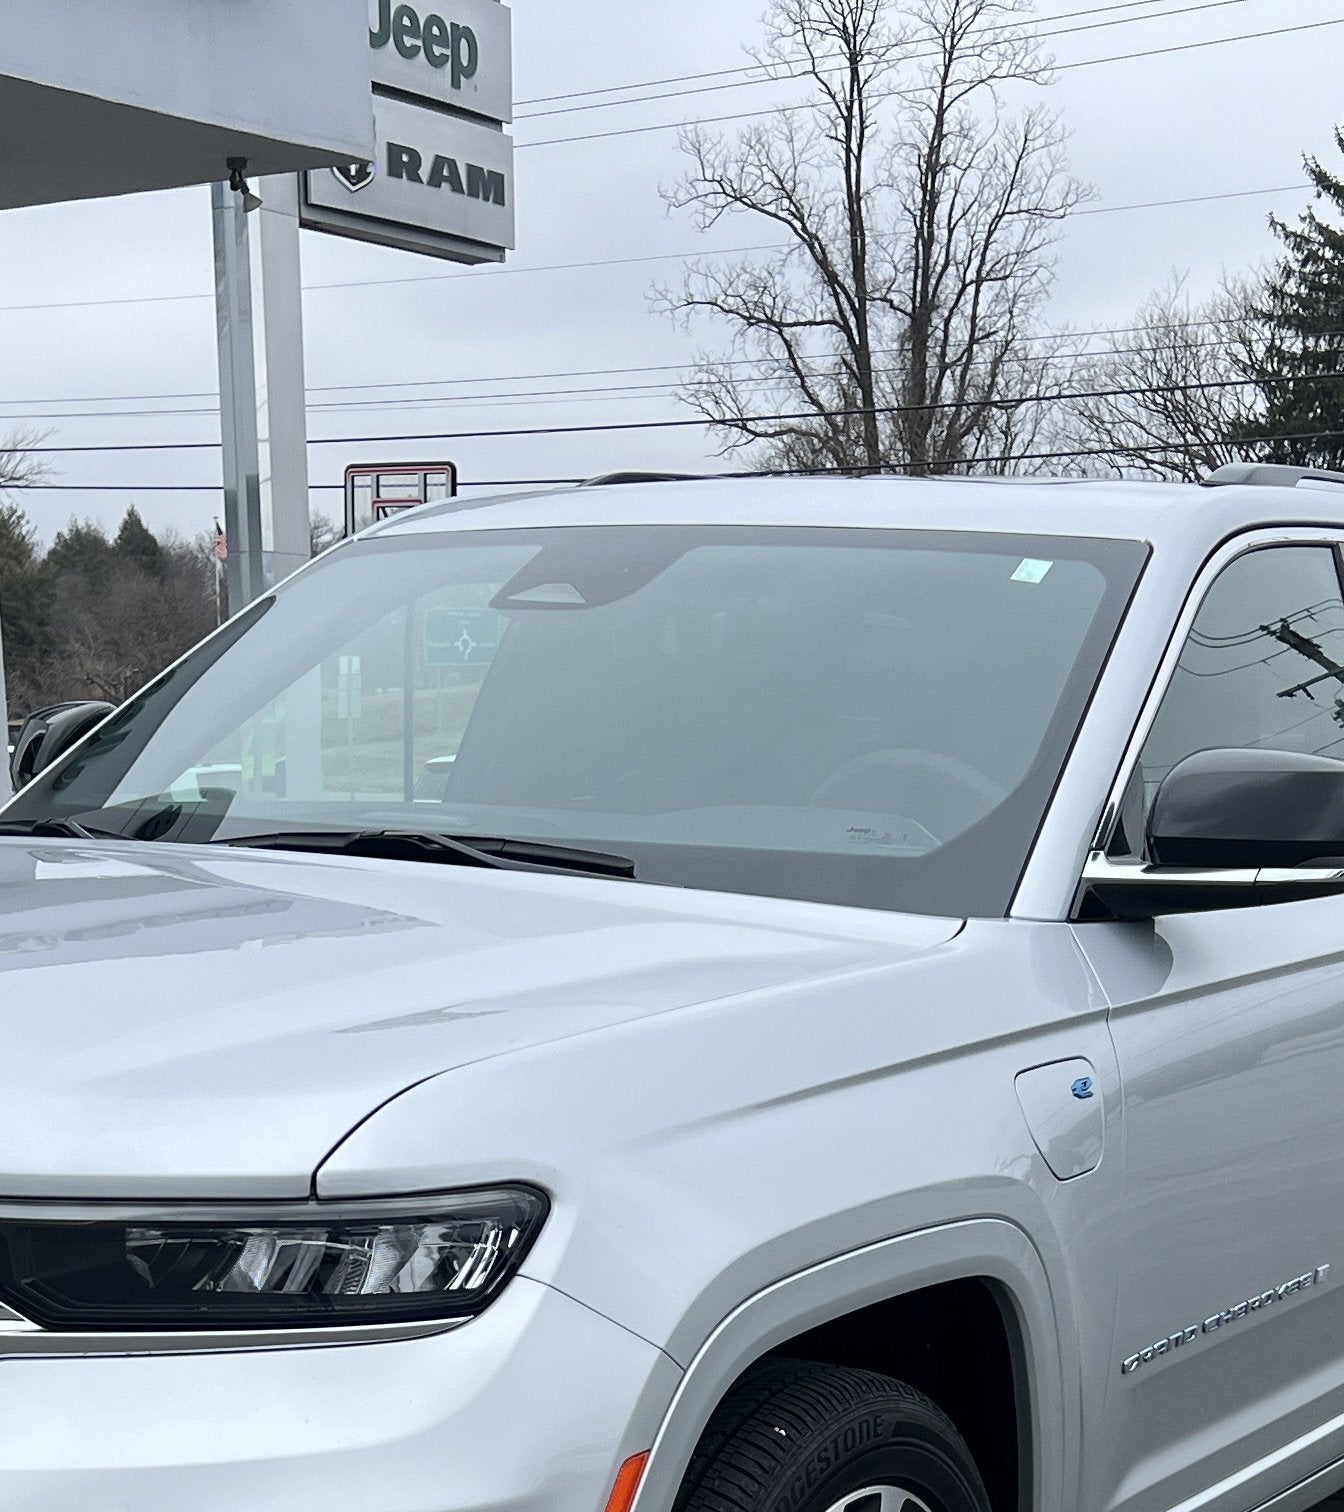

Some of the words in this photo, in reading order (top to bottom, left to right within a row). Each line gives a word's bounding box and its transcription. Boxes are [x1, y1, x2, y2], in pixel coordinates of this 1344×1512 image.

[369, 0, 478, 90] Jeep
[387, 141, 506, 206] RAM
[1121, 1325, 1198, 1375] GRAND
[1202, 1272, 1313, 1333] CHEROKEE
